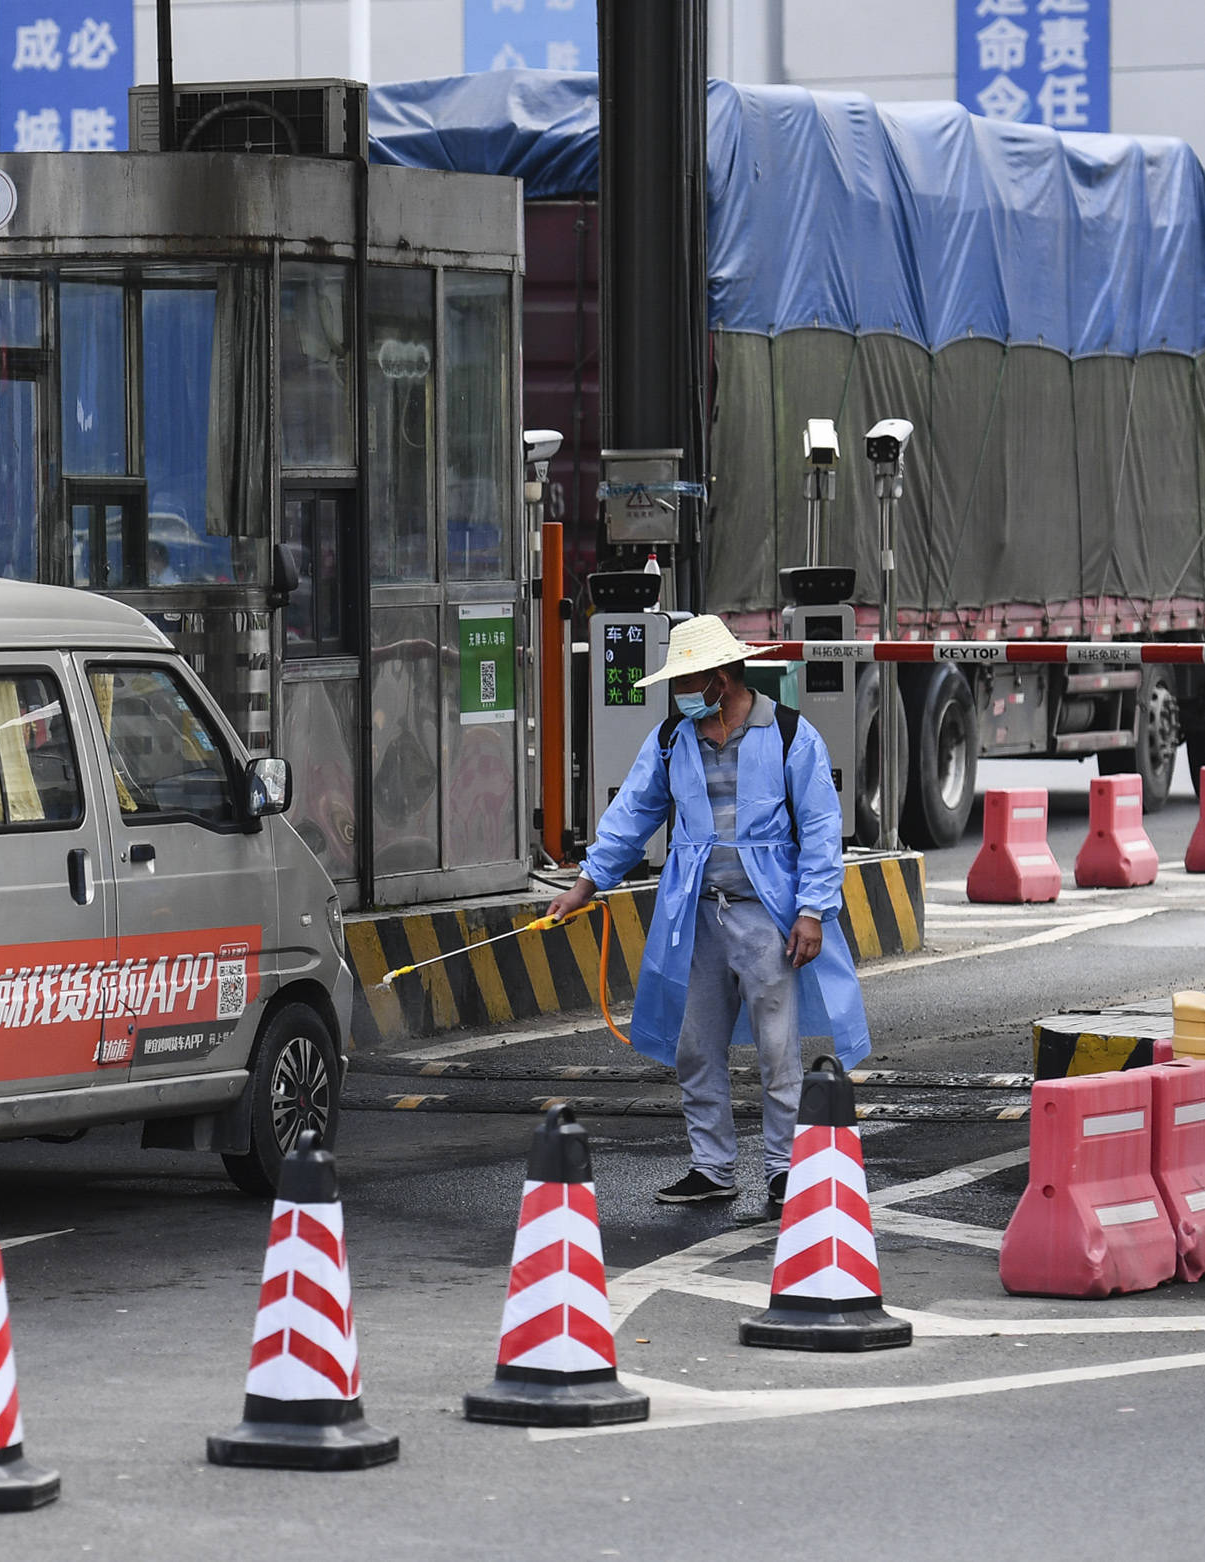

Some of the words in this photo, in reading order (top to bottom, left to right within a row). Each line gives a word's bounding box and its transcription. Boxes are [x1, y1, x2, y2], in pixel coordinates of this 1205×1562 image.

[975, 0, 1029, 122] 命令
[1037, 0, 1090, 126] 责任
[605, 625, 643, 643] 车位
[605, 648, 614, 663] 0
[812, 646, 864, 657] 科拓免取卡
[939, 648, 1000, 660] KEYTOP
[606, 667, 643, 685] 欢迎
[607, 687, 644, 704] 光临
